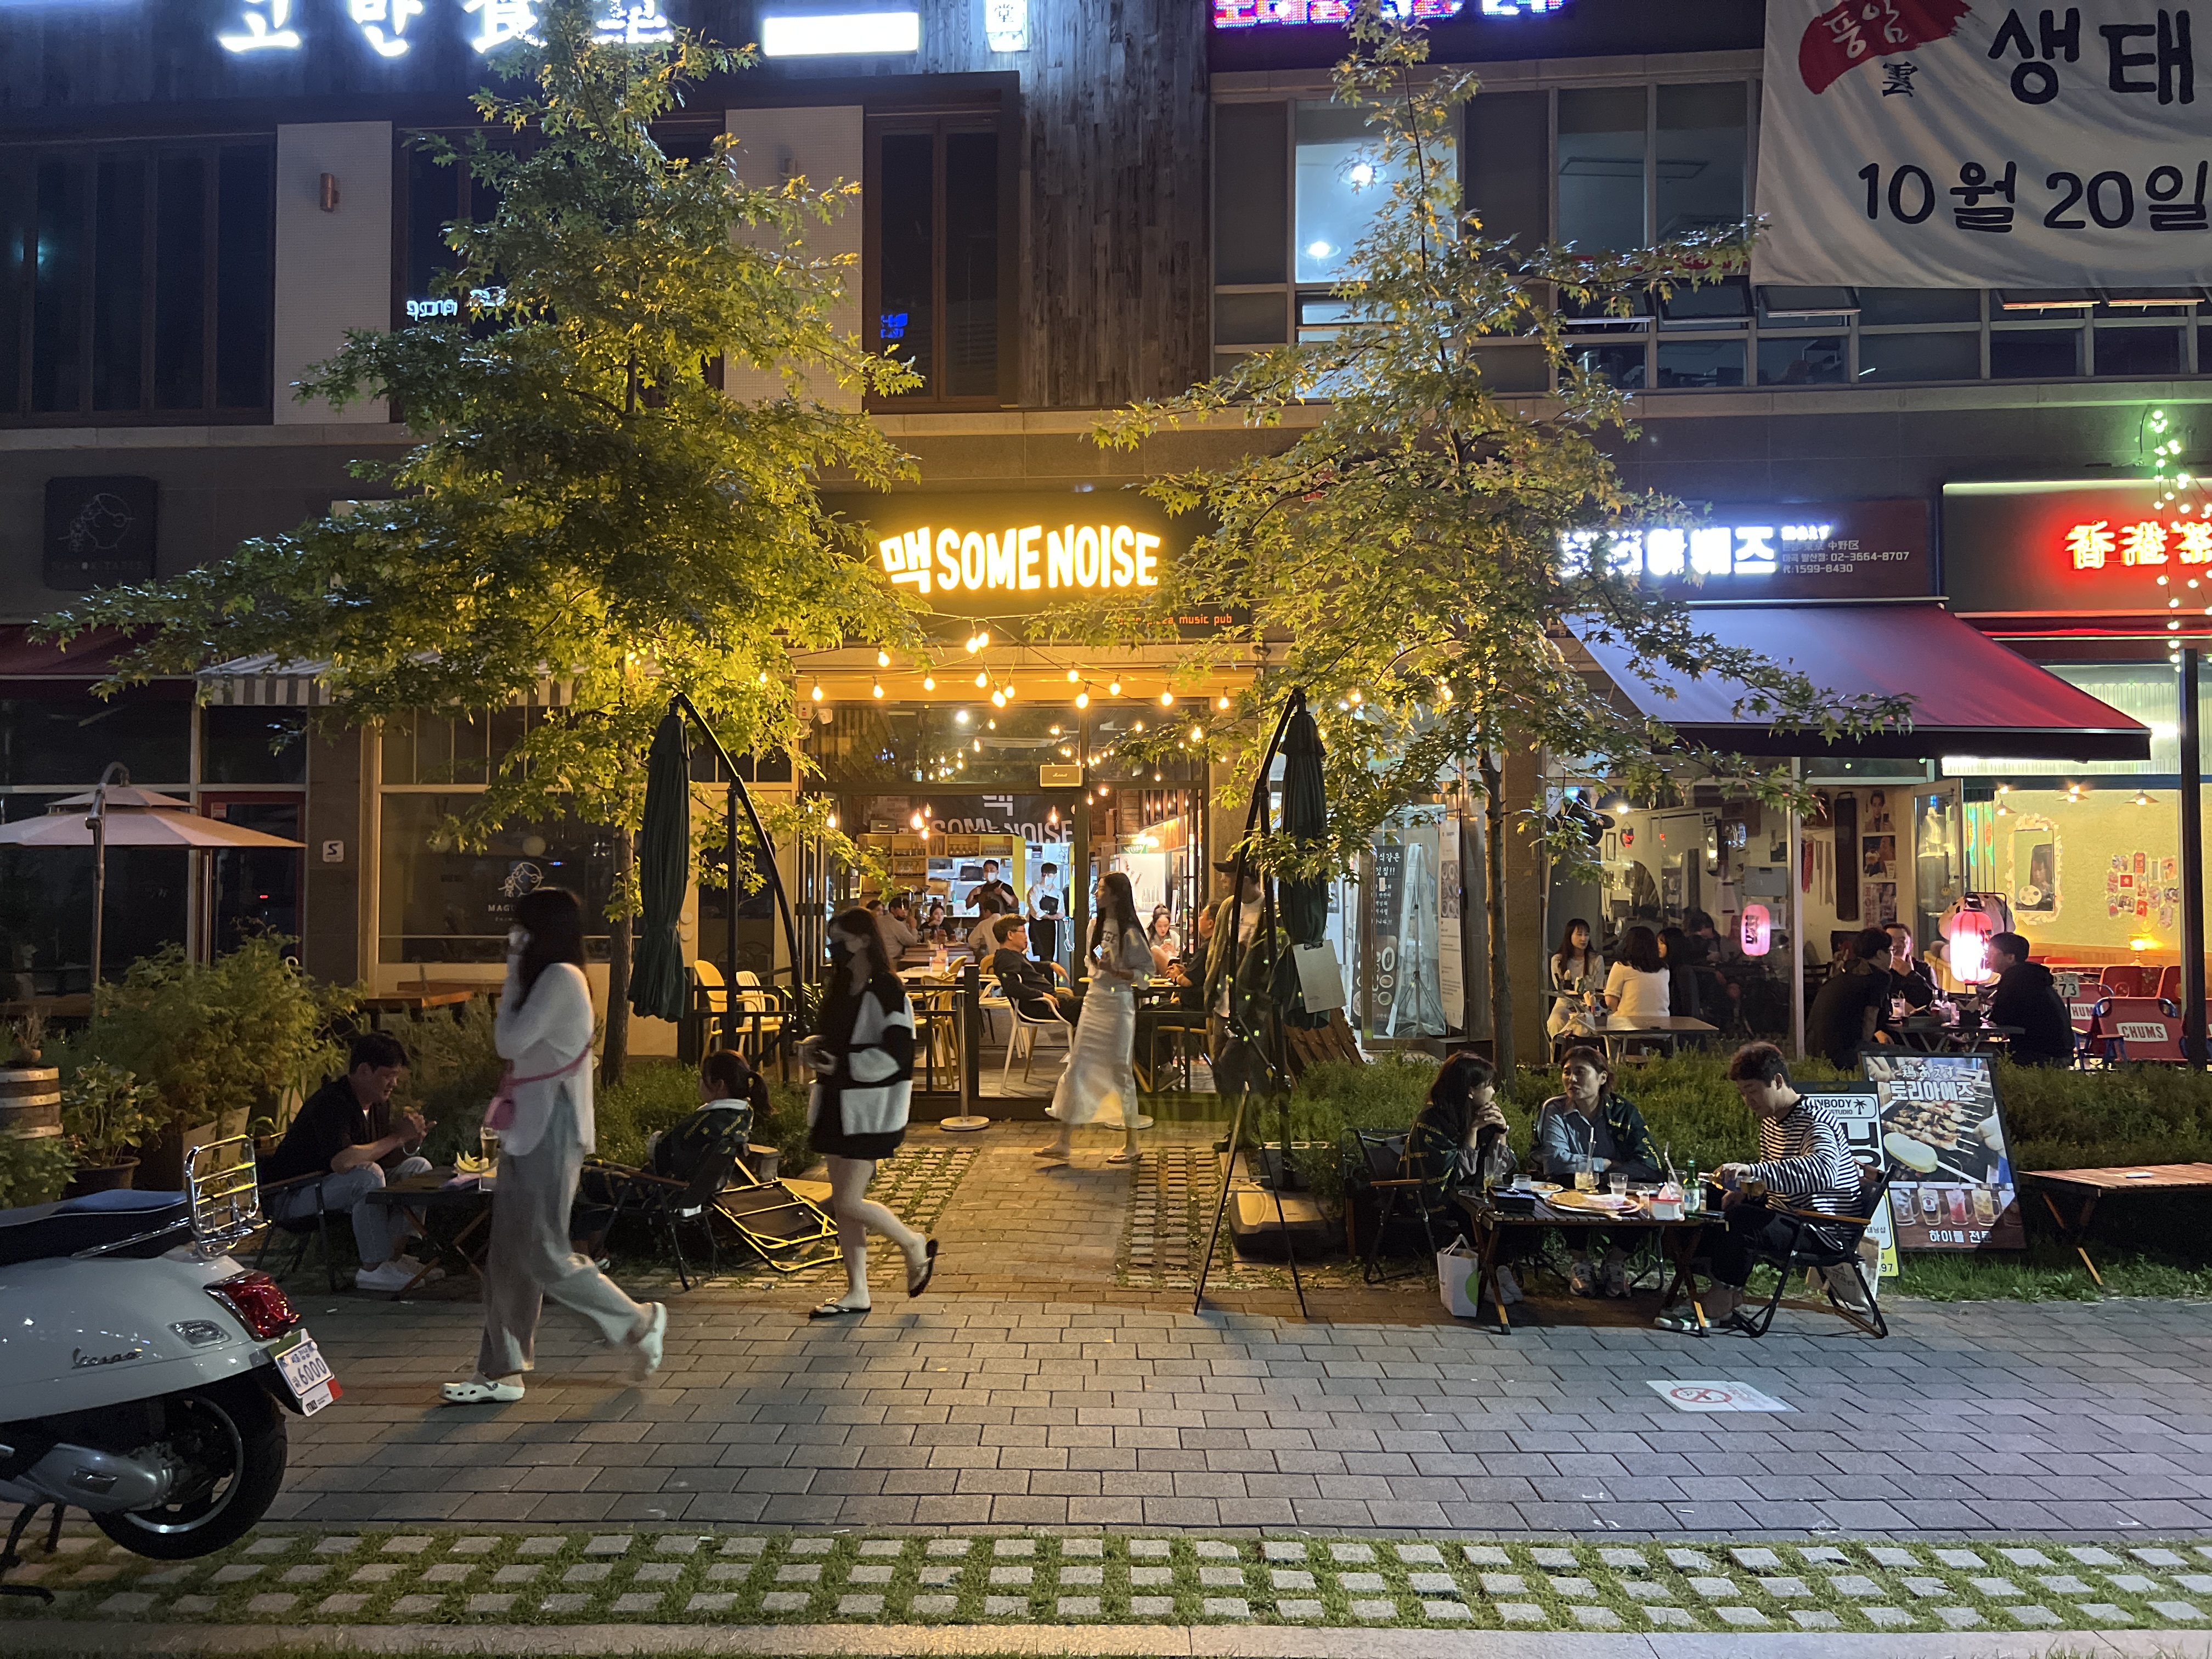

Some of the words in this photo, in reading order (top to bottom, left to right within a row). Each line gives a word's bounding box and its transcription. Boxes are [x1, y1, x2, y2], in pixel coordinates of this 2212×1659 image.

[1987, 8, 2194, 105] 생태
[1858, 161, 2017, 233] 10월
[2043, 161, 2209, 232] 20일
[1783, 553, 1799, 562] 마곡
[1830, 551, 1910, 562] 02-3664-8707
[1828, 540, 1859, 551] 中野区
[879, 526, 932, 594] 맥
[935, 525, 1042, 590] SOME
[1046, 524, 1161, 589] NOISE
[1179, 613, 1209, 624] music
[1214, 613, 1232, 627] pub
[2121, 1025, 2164, 1039] CHUMS
[1889, 1080, 1976, 1102] 토리아에즈
[297, 1357, 328, 1385] 6000
